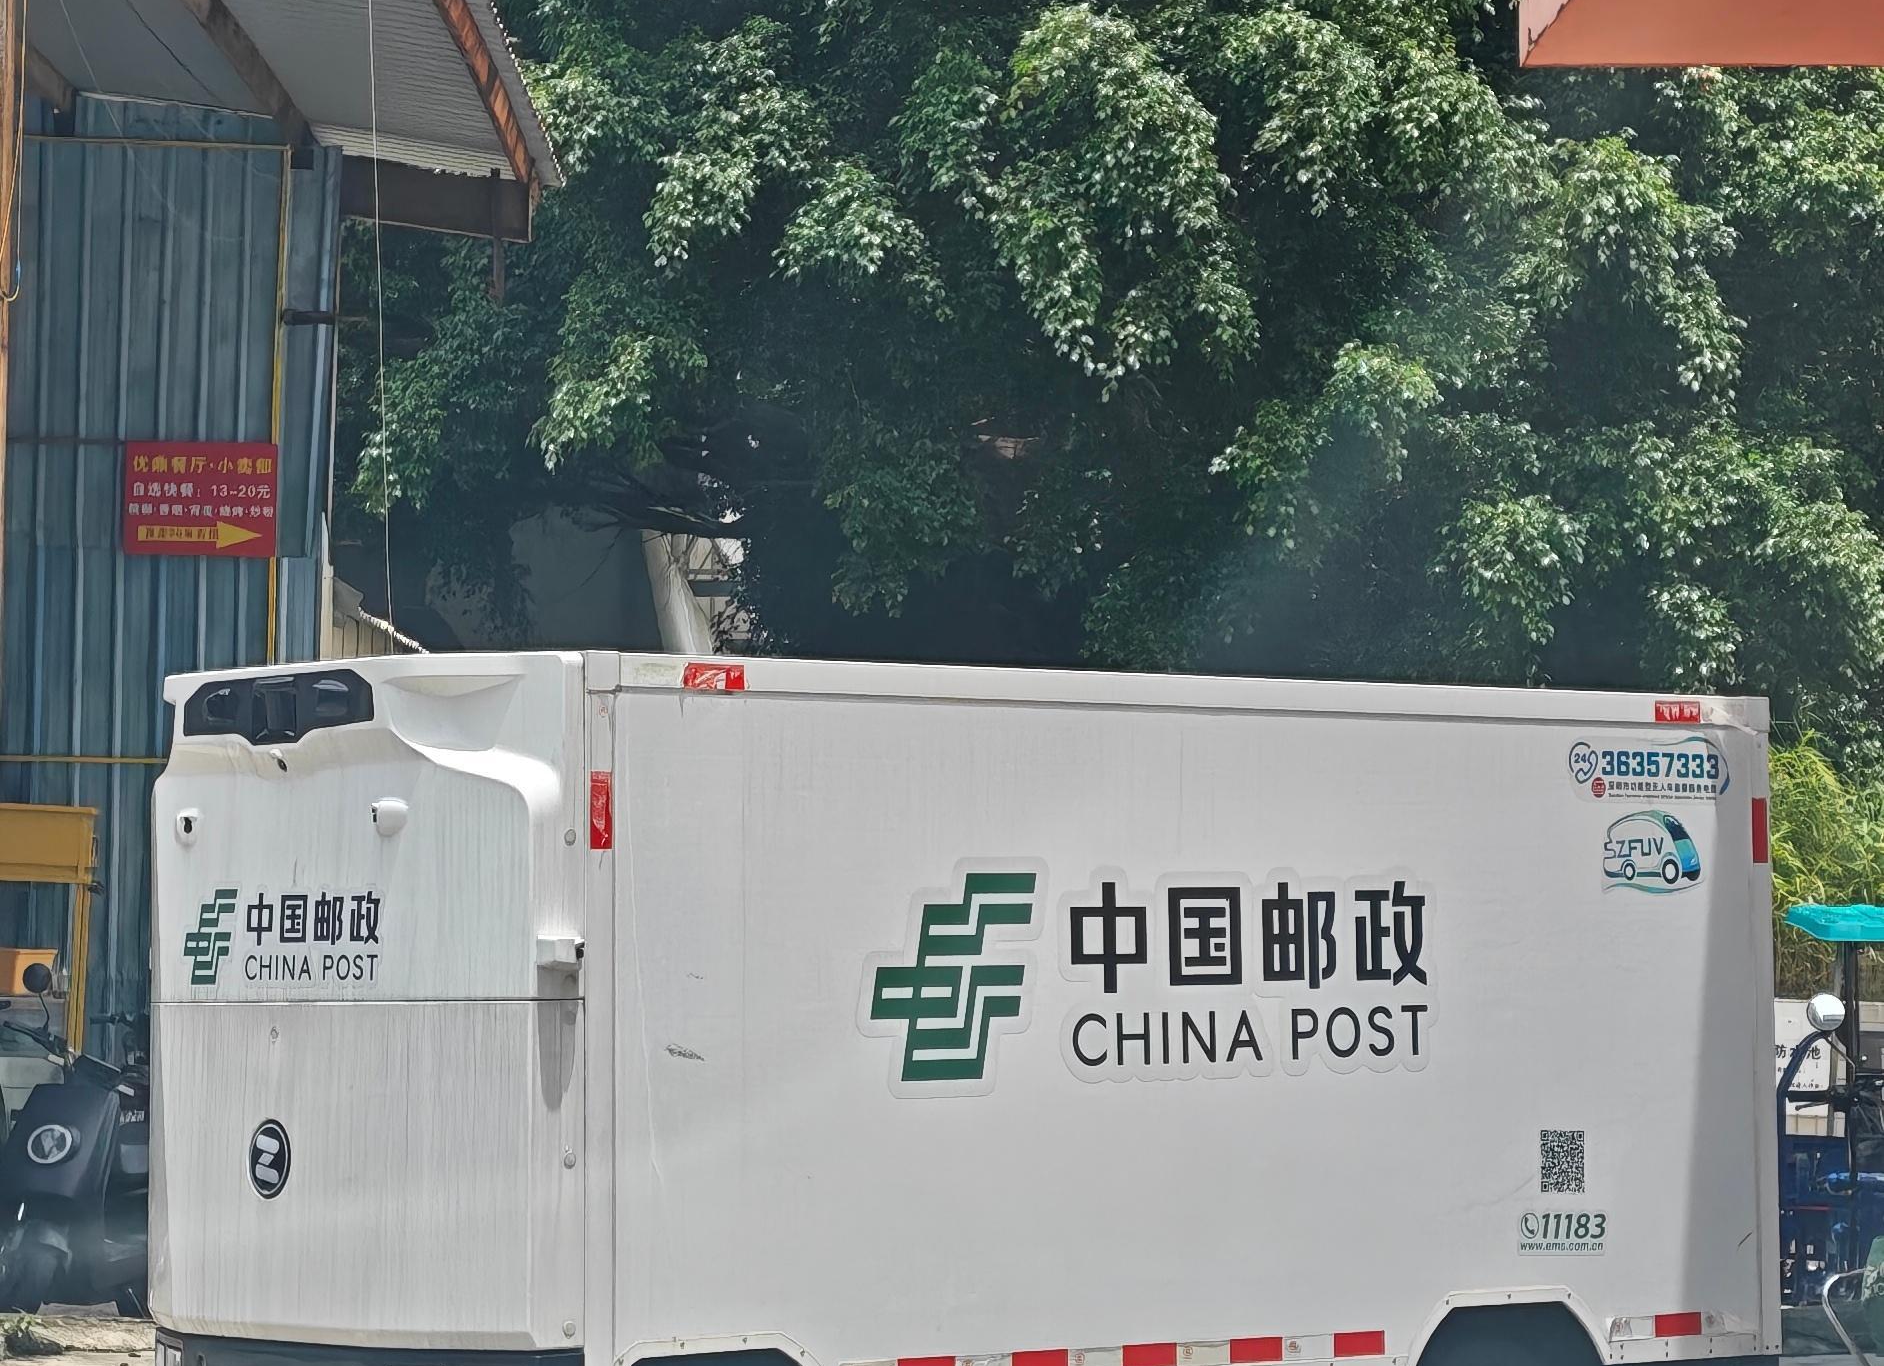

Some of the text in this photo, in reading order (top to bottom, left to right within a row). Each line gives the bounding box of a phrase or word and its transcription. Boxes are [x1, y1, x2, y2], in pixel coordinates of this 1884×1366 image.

[1574, 752, 1587, 764] 24
[1601, 750, 1720, 780] 36357333
[1603, 837, 1664, 859] SZFUV
[246, 891, 381, 946] 中国邮政
[1069, 880, 1428, 993] 中国邮政
[245, 954, 379, 981] CHINA POST
[1072, 1003, 1429, 1067] CHINA POST
[1541, 1212, 1607, 1240] 11183
